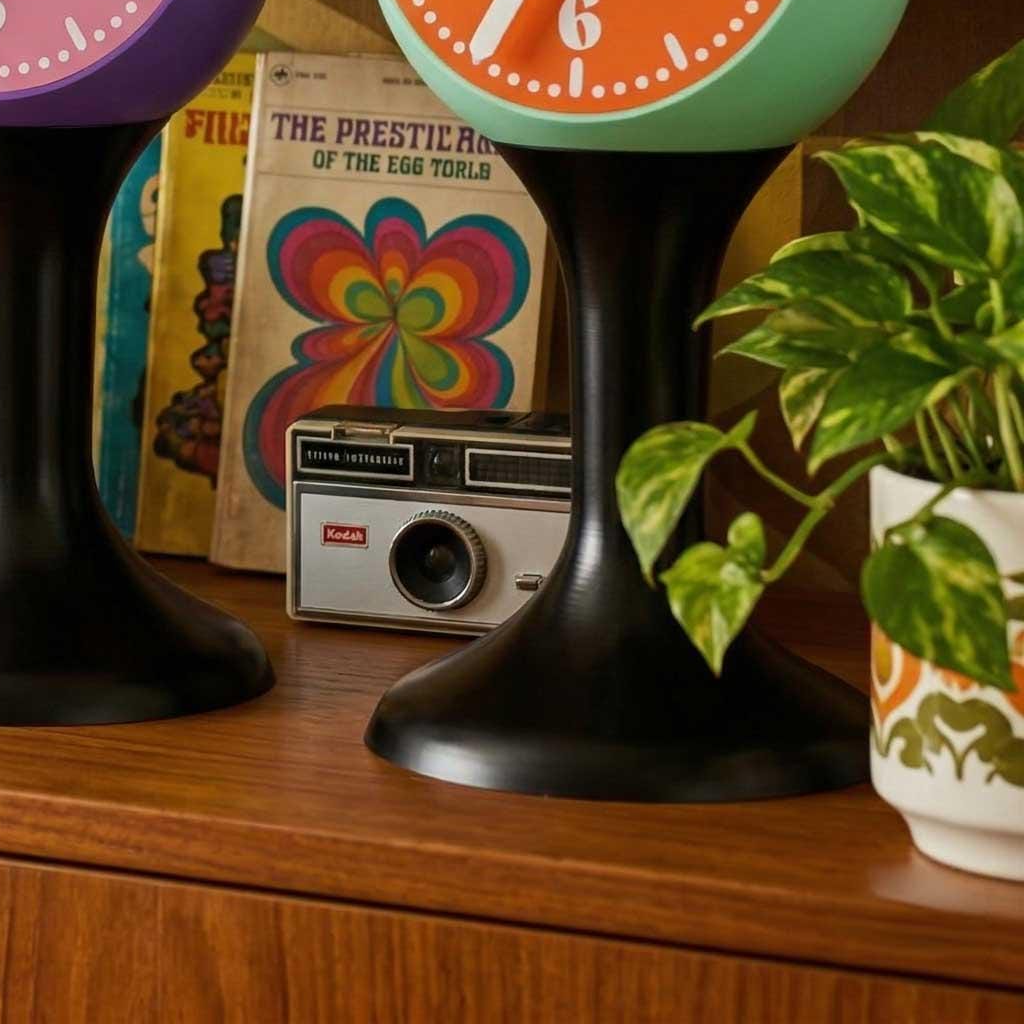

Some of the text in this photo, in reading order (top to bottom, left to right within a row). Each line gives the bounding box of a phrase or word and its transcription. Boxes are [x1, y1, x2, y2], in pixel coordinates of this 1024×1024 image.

[271, 112, 327, 143] THE
[312, 149, 338, 169] OF
[343, 151, 381, 173] THE
[326, 527, 365, 542] Kodak
